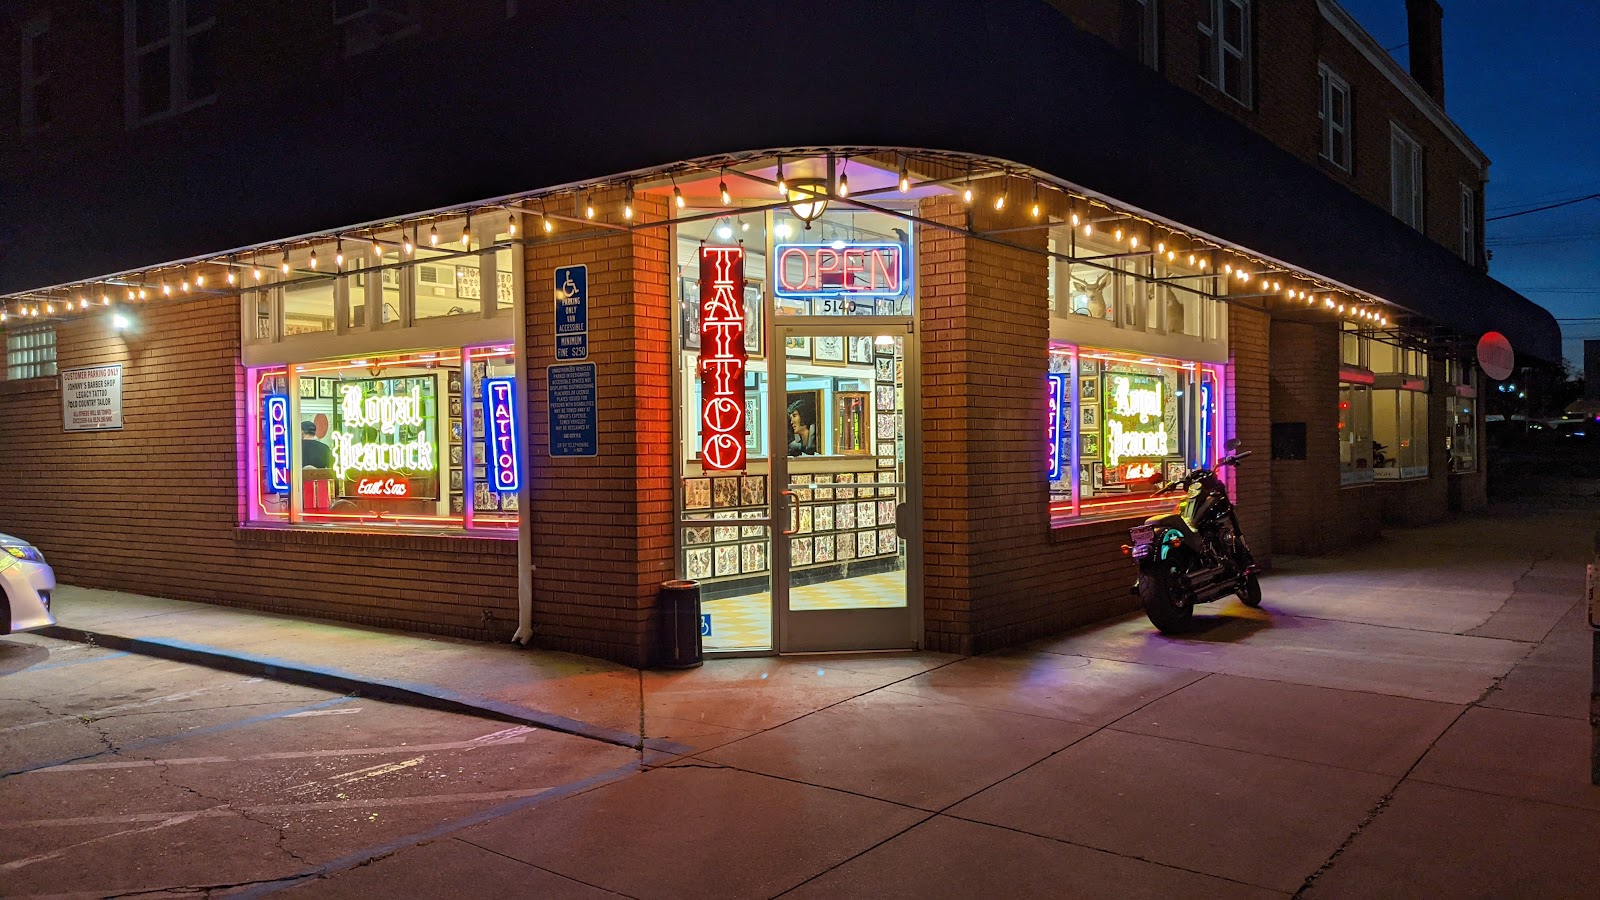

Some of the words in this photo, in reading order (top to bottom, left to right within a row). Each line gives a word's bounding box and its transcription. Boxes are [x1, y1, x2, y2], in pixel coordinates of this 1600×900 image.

[780, 248, 898, 290] OPEN
[562, 297, 580, 306] PARKING
[824, 300, 856, 312] 5140
[566, 306, 577, 314] ONLY
[559, 323, 584, 332] ACCESSIBLE
[561, 336, 582, 346] MINIMUM
[558, 348, 568, 357] FINE
[572, 347, 585, 356] $250
[703, 248, 744, 468] TATTOO
[64, 371, 86, 380] CUSTOMER
[88, 369, 106, 378] PARKING
[107, 368, 119, 376] ONLY
[68, 382, 86, 390] JOHNNY'S
[88, 380, 103, 388] BARBER
[104, 379, 116, 387] SHOP
[76, 390, 92, 398] LEGACY
[92, 389, 107, 397] TATTOO
[79, 399, 96, 407] COUNTRY
[340, 385, 423, 434] Royal
[494, 386, 513, 484] TATTOO
[272, 403, 288, 484] OPEN
[331, 430, 432, 480] Peacock
[358, 479, 382, 494] East
[383, 478, 407, 495] Sac
